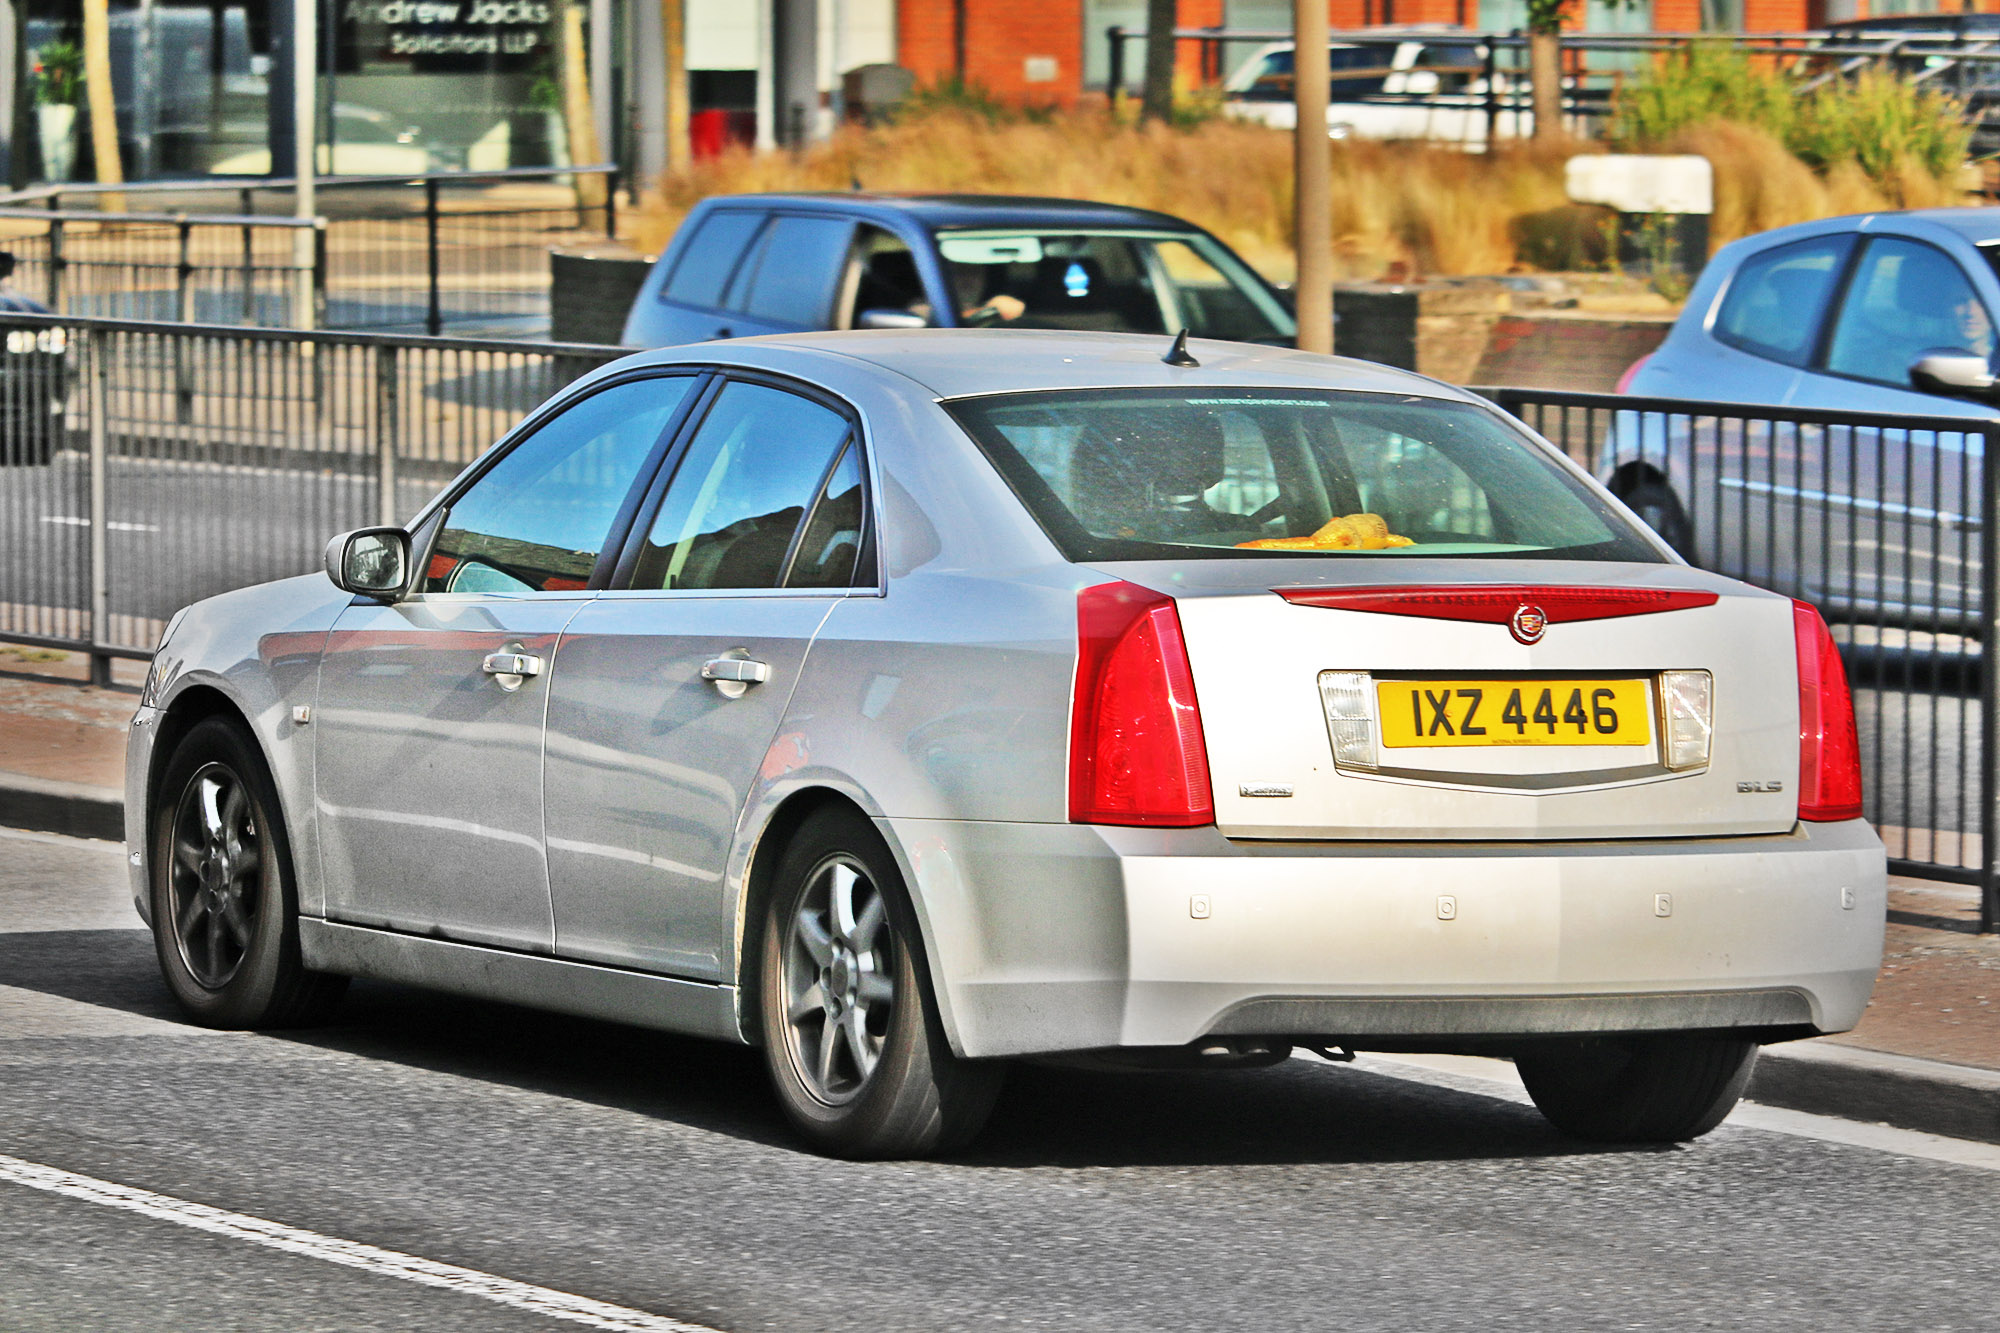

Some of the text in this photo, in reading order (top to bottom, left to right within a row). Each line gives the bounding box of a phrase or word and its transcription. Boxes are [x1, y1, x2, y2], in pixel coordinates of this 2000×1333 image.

[344, 1, 549, 24] Andrew Jacks
[391, 32, 538, 54] Solicitors LLP
[1411, 687, 1619, 737] IXZ 4446
[1736, 781, 1783, 793] BLS
